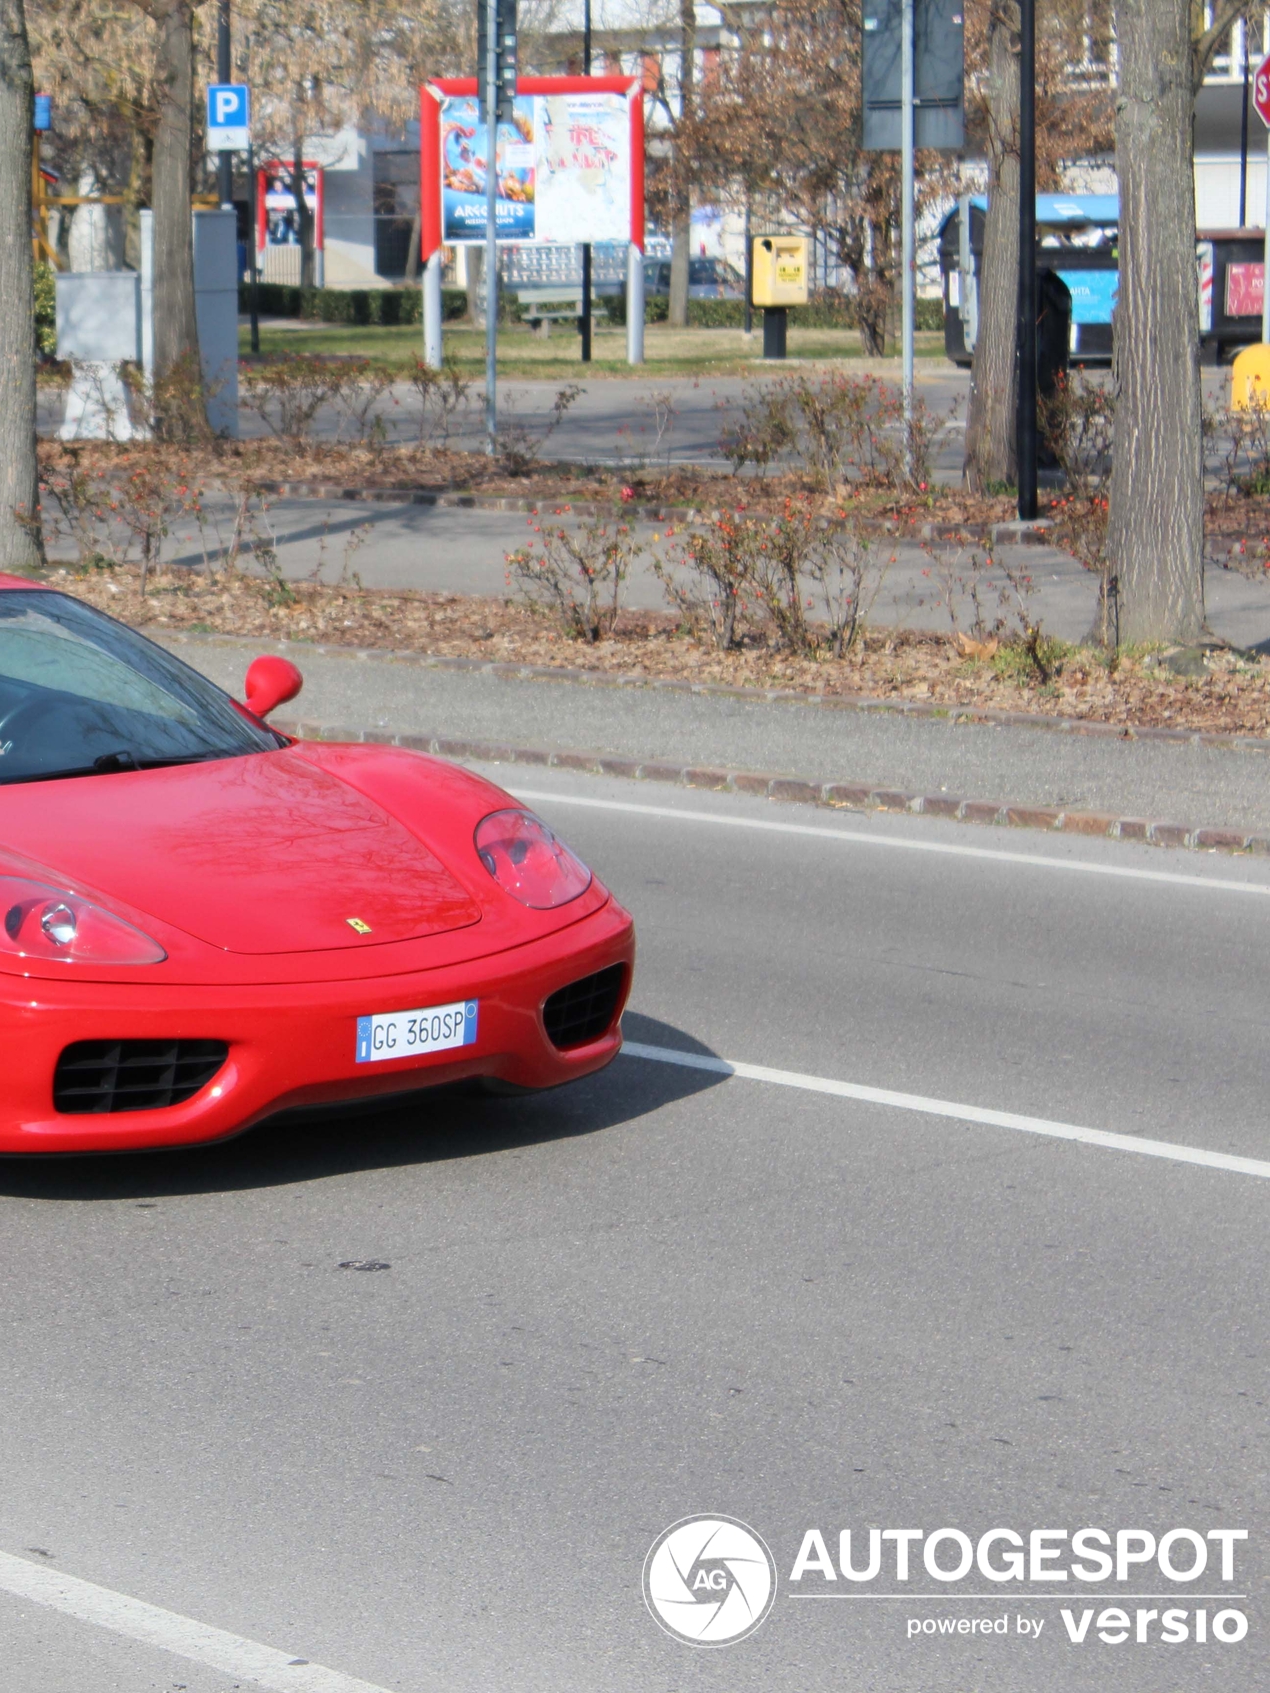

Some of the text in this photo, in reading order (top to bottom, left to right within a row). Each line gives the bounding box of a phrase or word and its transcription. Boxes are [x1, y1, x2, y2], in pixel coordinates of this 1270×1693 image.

[217, 91, 238, 123] P
[1070, 286, 1090, 296] ARTA
[373, 1011, 464, 1050] GG 360SP
